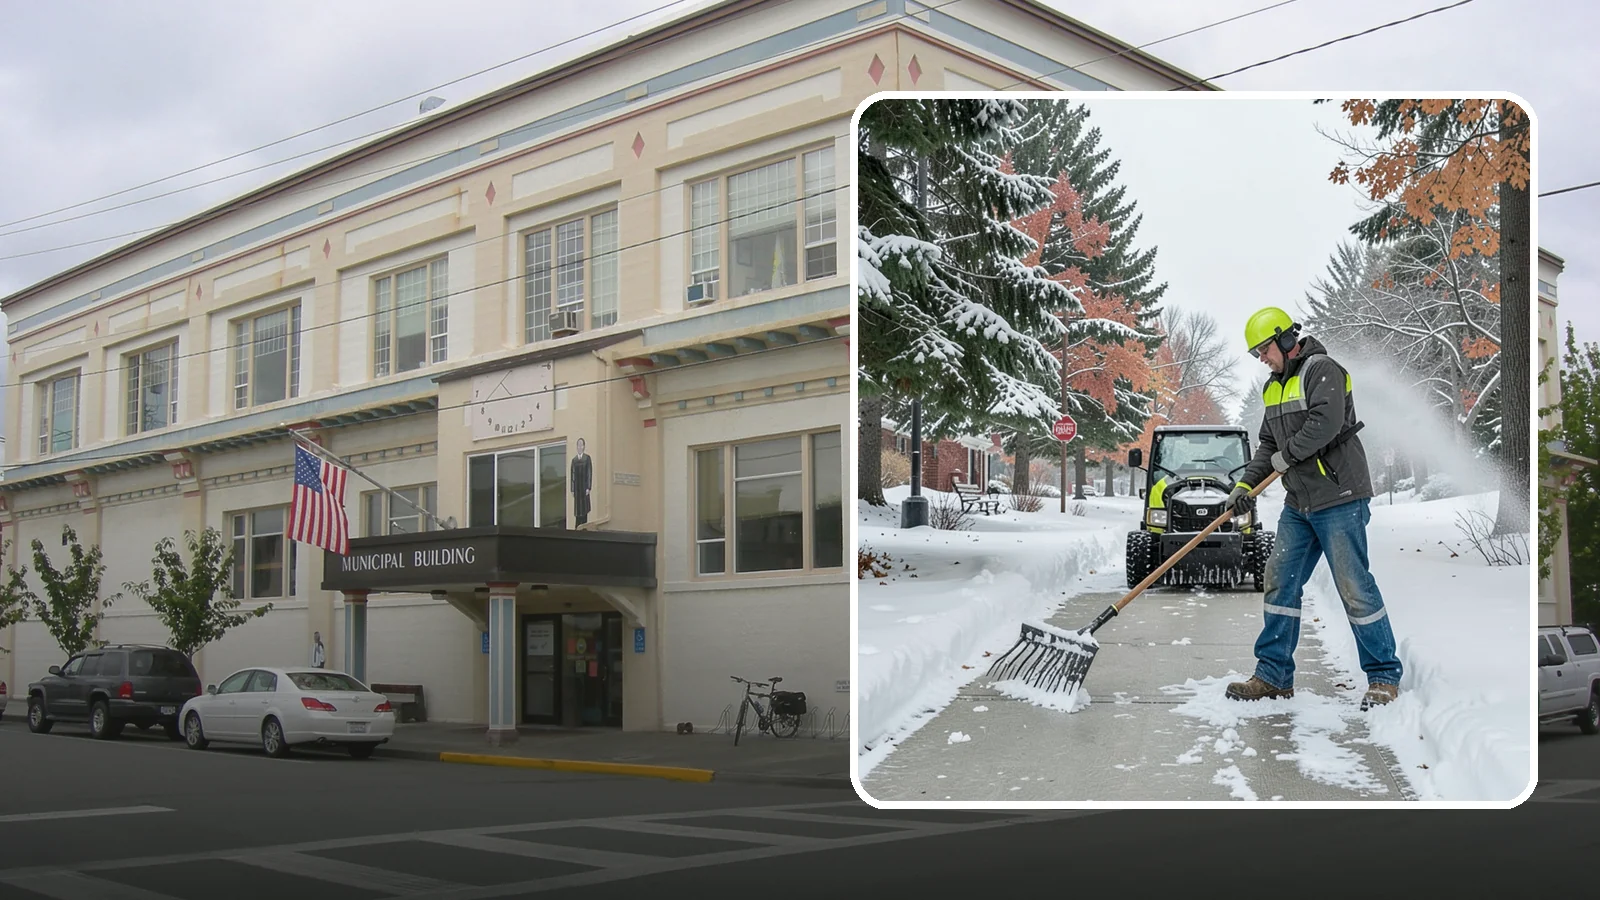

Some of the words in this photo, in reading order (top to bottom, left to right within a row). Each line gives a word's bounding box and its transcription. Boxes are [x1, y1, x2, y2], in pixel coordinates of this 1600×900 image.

[475, 390, 479, 398] 7
[481, 407, 485, 415] 8
[487, 417, 492, 426] 9
[494, 423, 500, 432] 10
[501, 425, 506, 434] 11
[507, 425, 513, 433] 12
[521, 420, 525, 428] 2
[528, 413, 533, 422] 3
[536, 402, 540, 410] 4
[342, 552, 405, 572] MUNICIPAL
[414, 546, 475, 567] BUILDING
